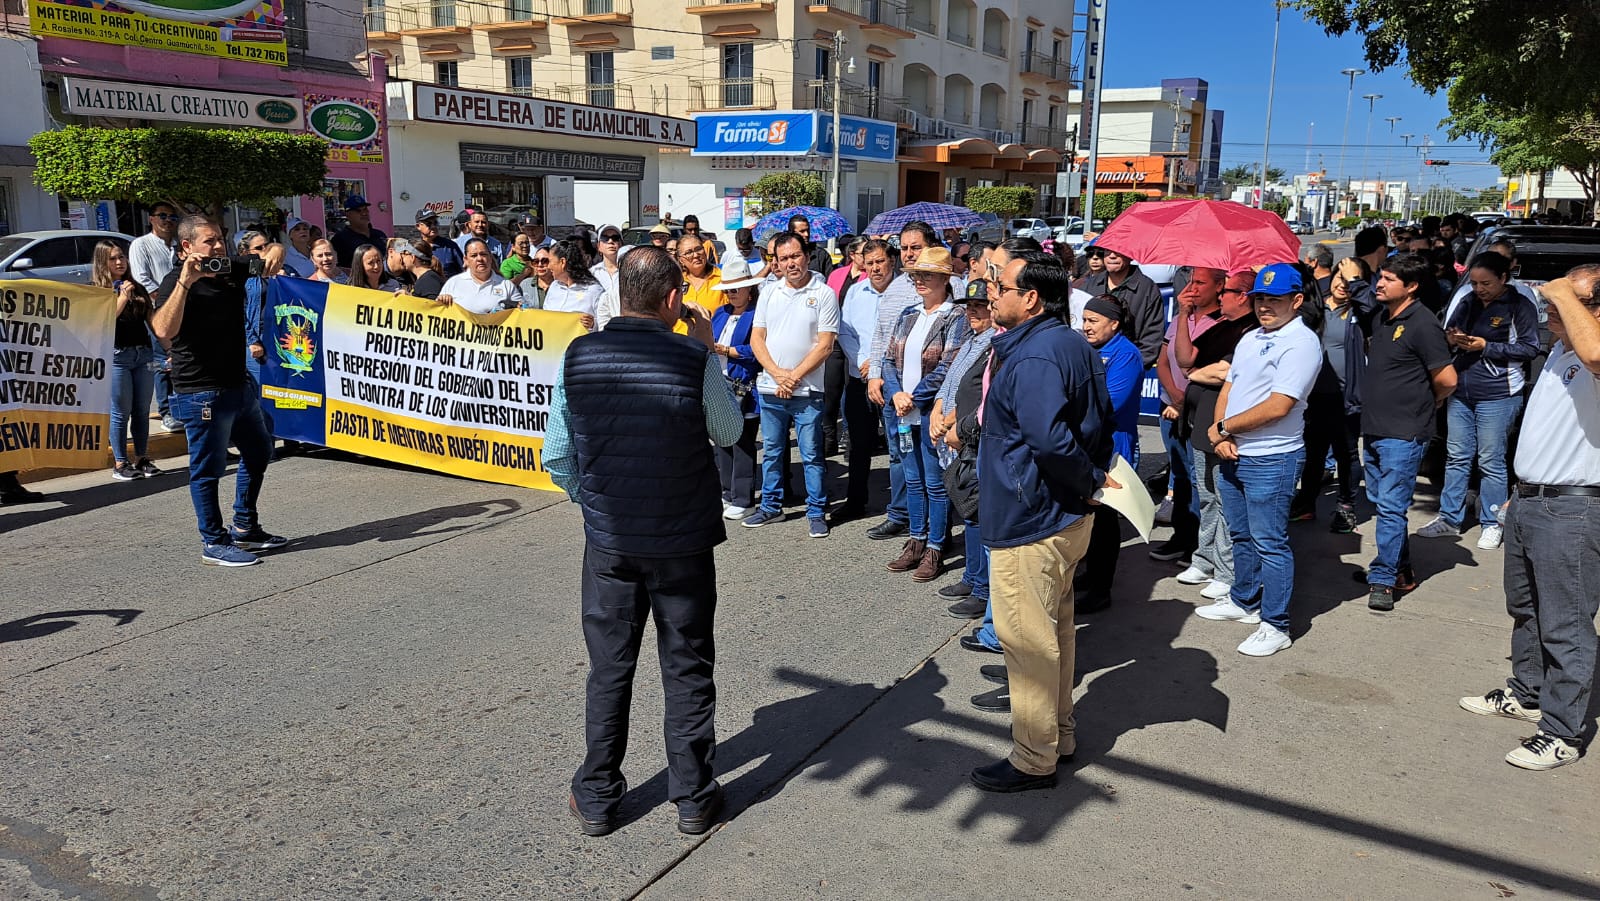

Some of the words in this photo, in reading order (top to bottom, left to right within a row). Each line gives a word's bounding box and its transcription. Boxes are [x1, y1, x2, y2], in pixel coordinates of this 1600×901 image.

[36, 5, 97, 25] MATERIAL
[101, 14, 131, 30] PARA
[134, 19, 149, 33] TU
[151, 22, 218, 42] CREATIVIDAD
[41, 23, 50, 31] A.
[52, 24, 83, 35] Rosales
[84, 27, 98, 37] No.
[139, 35, 163, 46] Centro
[226, 43, 243, 57] Tel.
[244, 46, 262, 59] 732
[263, 49, 286, 62] 7676
[75, 86, 166, 113] MATERIAL
[171, 94, 249, 119] CREATIVO
[434, 92, 534, 126] PAPELERA
[544, 105, 566, 129] DE
[714, 120, 789, 145] FarmaSí
[468, 152, 508, 165] JOYERIA
[513, 150, 558, 168] GARCIA
[0, 289, 17, 314] S
[23, 292, 71, 320] BAJO
[355, 304, 374, 327] EN
[377, 307, 393, 330] LA
[397, 310, 424, 335] UAS
[427, 314, 504, 347] TRABAJAMOS
[504, 326, 544, 352] BAJO
[42, 353, 106, 381] ESTADO
[365, 331, 430, 362] PROTESTA
[432, 342, 457, 368] POR
[460, 347, 475, 371] LA
[476, 346, 531, 378] POLÍTICA
[326, 349, 341, 372] DE
[343, 357, 412, 385] REPRESIÓN
[413, 365, 434, 390] DEL
[438, 370, 495, 400] GOBIERNO
[497, 379, 523, 404] DEL
[1141, 378, 1159, 399] HA
[340, 376, 356, 399] EN
[357, 380, 405, 411] CONTRA
[408, 391, 425, 414] DE
[425, 394, 448, 419] LOS
[46, 423, 101, 451] MOYA!
[329, 409, 369, 440] ¡BASTA
[372, 418, 388, 443] DE
[386, 421, 446, 457] MENTIRAS
[446, 433, 489, 465] RUBÉN
[491, 440, 537, 473] ROCHA
